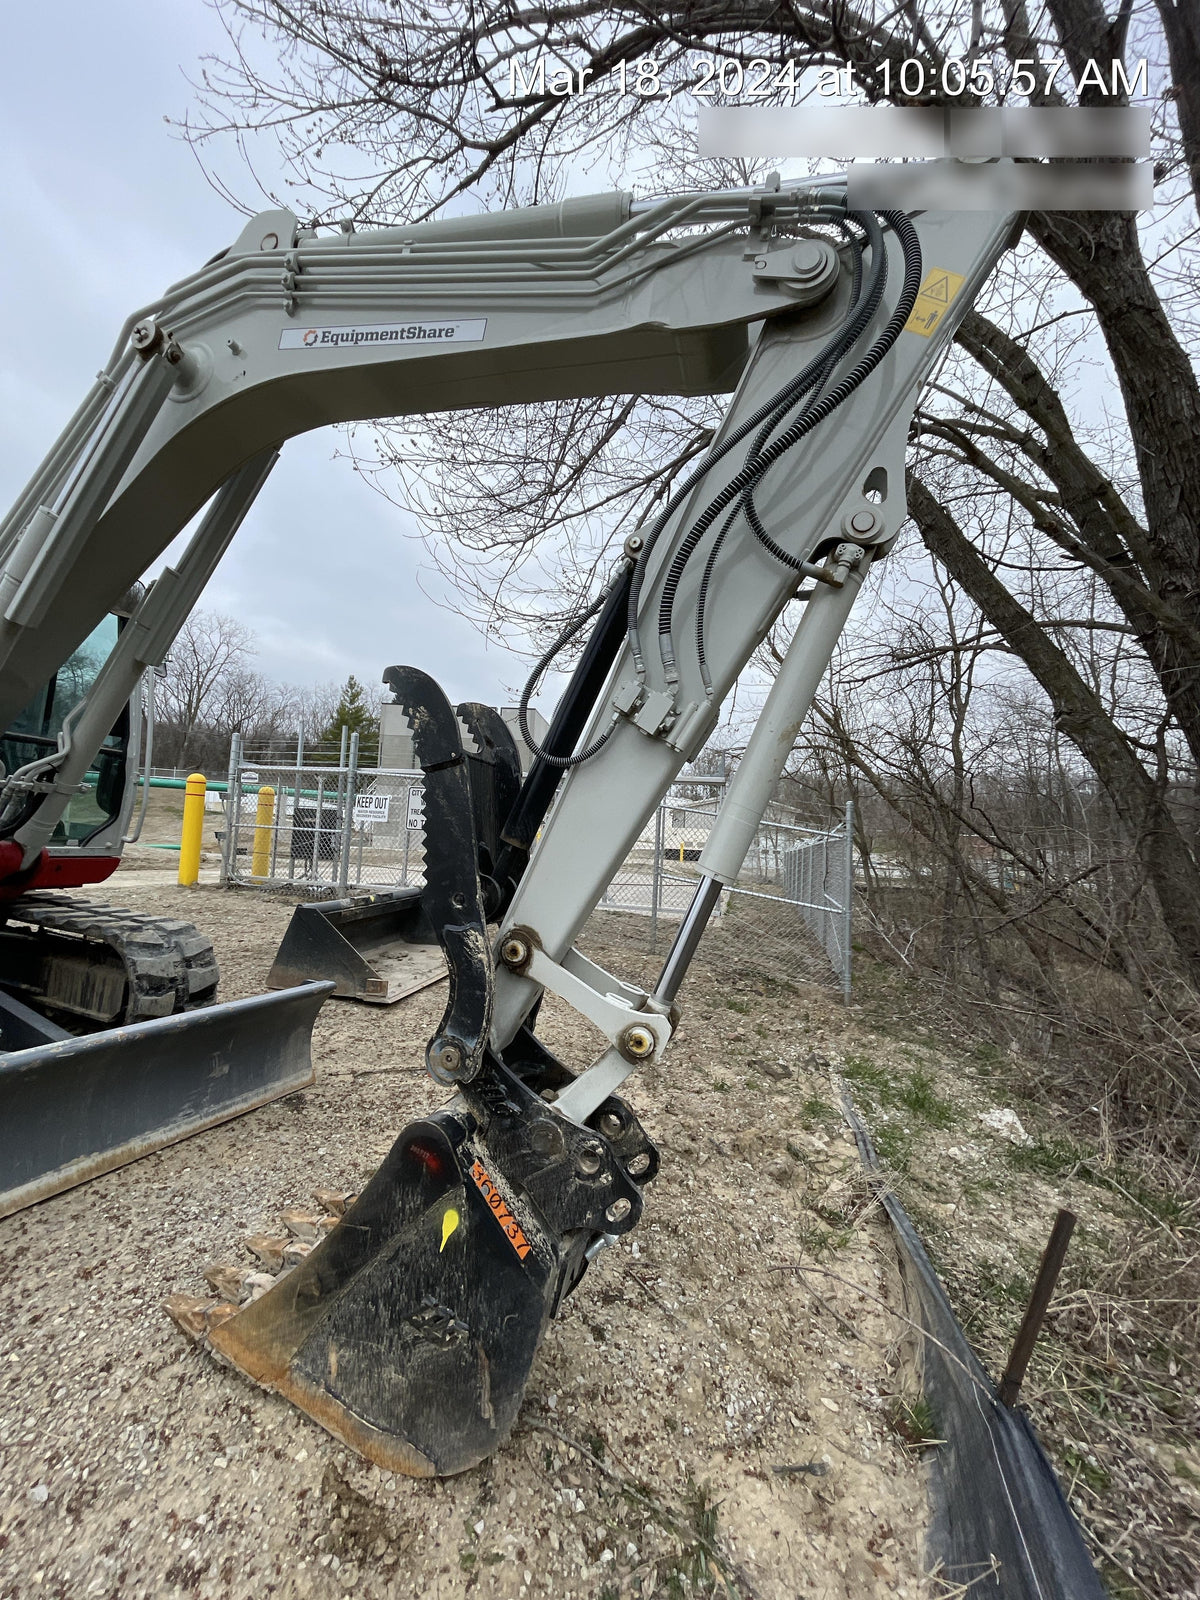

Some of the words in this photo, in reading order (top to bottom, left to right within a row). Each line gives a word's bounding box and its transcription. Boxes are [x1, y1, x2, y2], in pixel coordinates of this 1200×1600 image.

[319, 326, 455, 346] EquipmentShare
[356, 796, 373, 808] KEEP
[374, 797, 388, 809] OUT
[408, 819, 418, 828] NO
